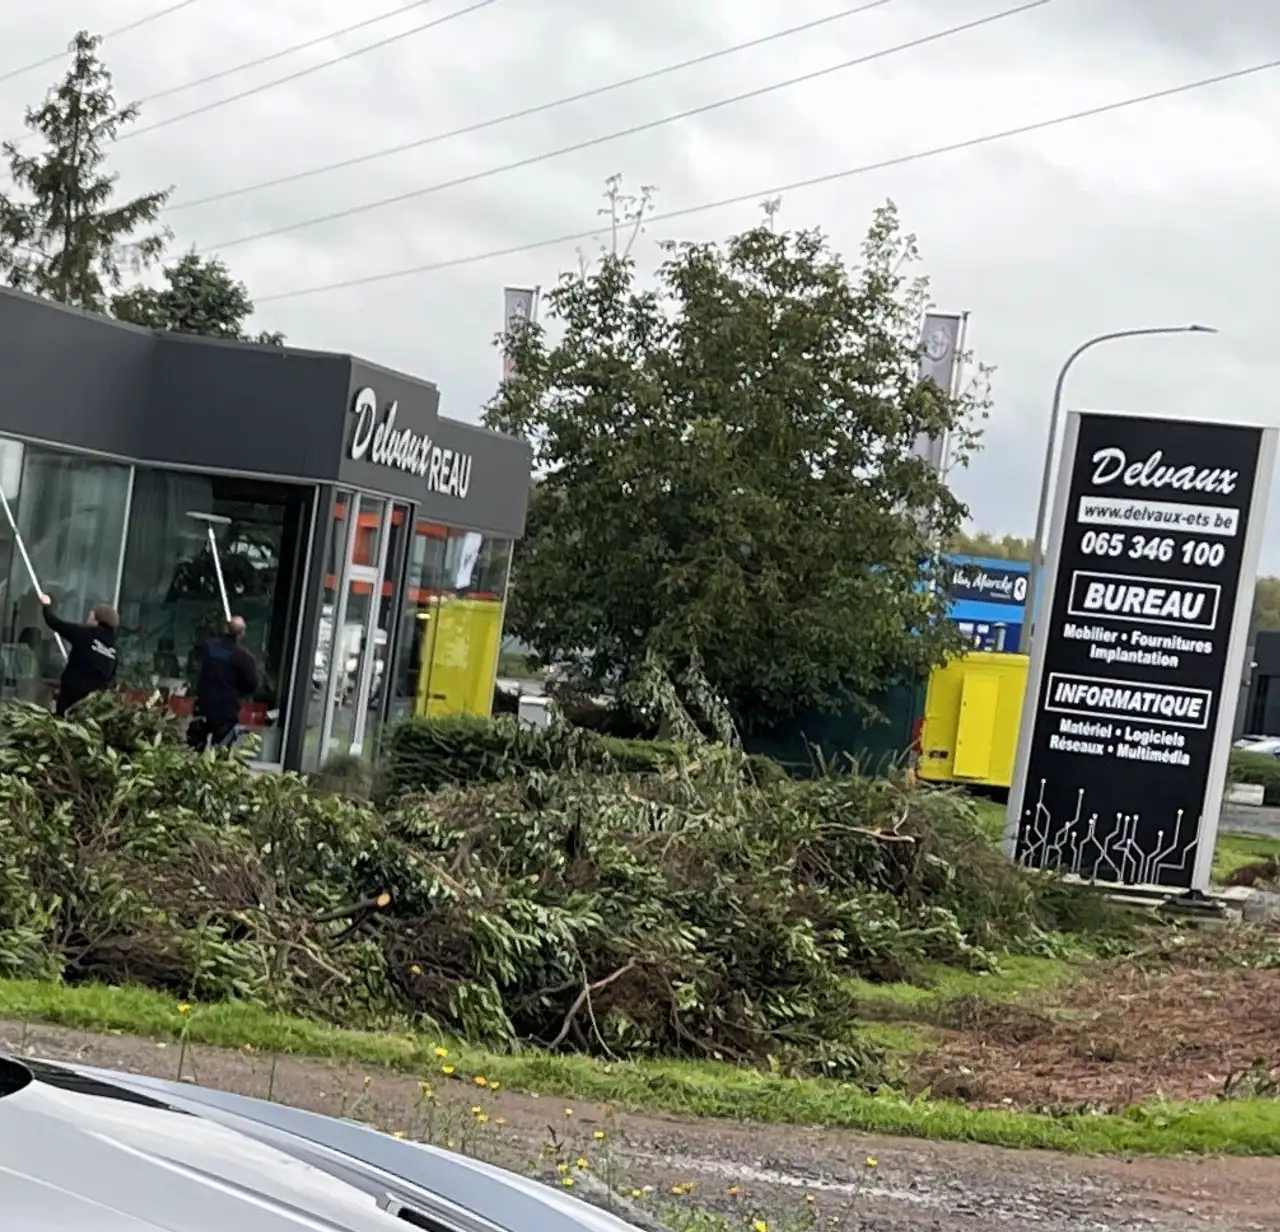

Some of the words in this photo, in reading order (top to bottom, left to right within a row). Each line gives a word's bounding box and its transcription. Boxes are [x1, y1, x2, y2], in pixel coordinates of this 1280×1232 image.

[351, 387, 432, 477] Delvaux
[428, 446, 472, 499] REAU
[1092, 447, 1238, 494] Delvaux
[1081, 531, 1125, 557] 065
[1128, 535, 1175, 562] 346
[1182, 540, 1225, 567] 100
[1084, 582, 1205, 619] BUREAU
[1063, 623, 1118, 644] Mobilier
[1130, 630, 1213, 654] Fournitures
[1090, 644, 1179, 668] Implantation
[1054, 682, 1203, 718] INFORMATIQUE
[1049, 734, 1104, 755] Réseaux
[1116, 743, 1190, 766] Multimédia
[1059, 717, 1112, 738] Matériel
[1124, 726, 1185, 747] Logiciels
